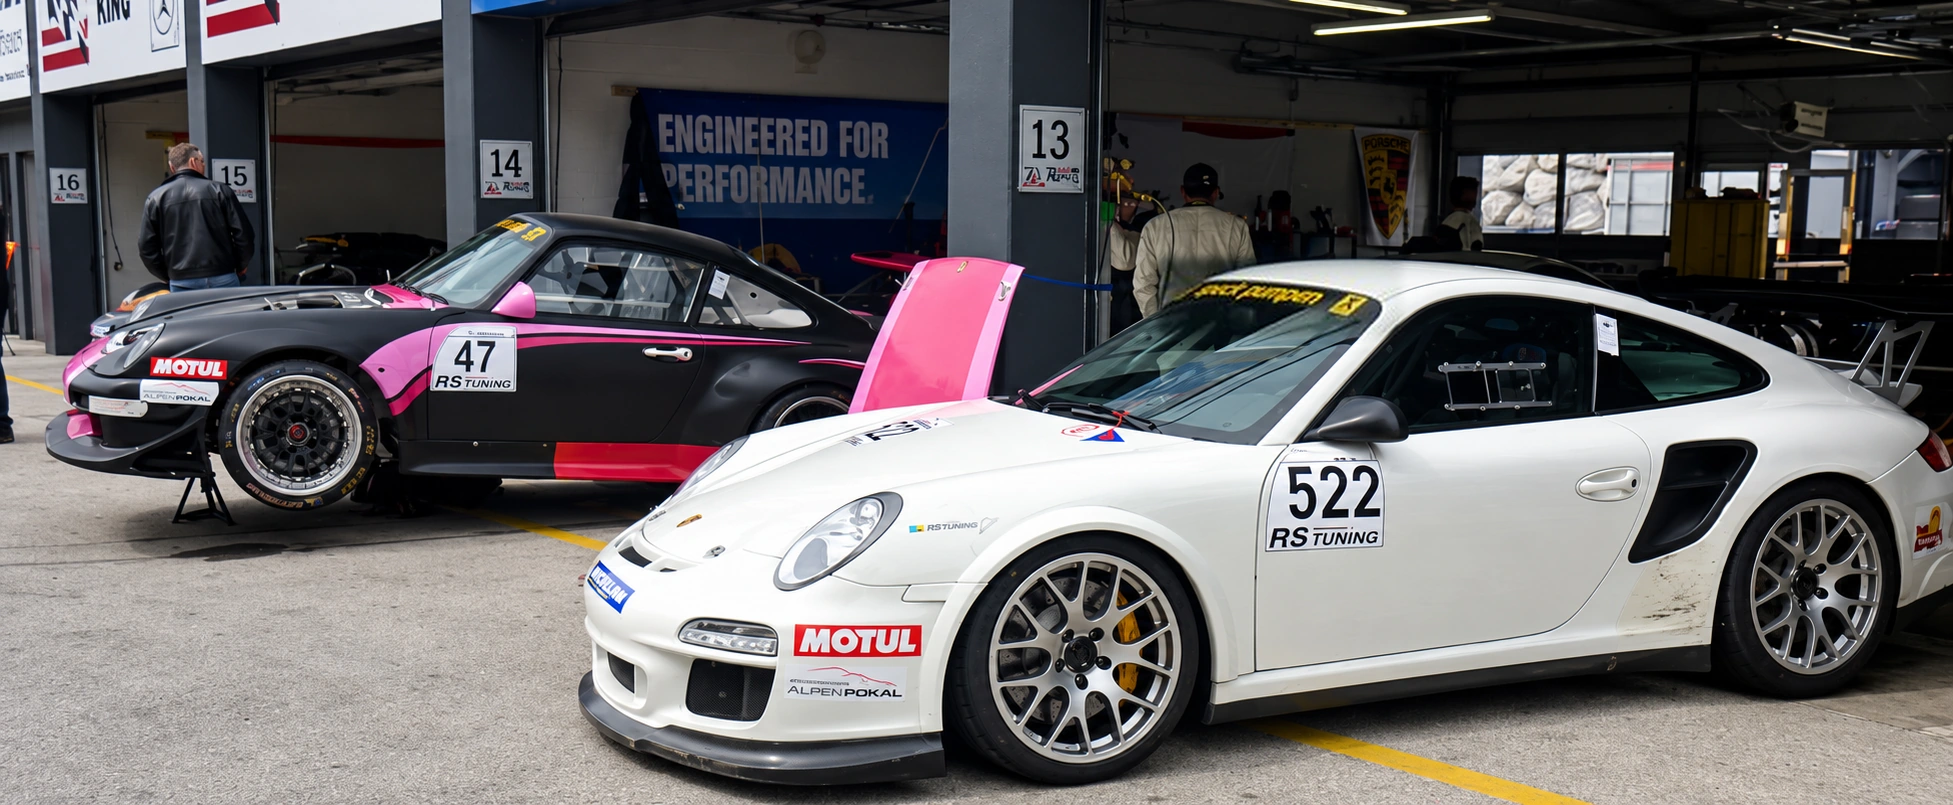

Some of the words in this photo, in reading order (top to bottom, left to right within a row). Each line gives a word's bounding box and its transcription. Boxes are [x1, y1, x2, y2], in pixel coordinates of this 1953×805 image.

[97, 0, 131, 26] KING
[658, 113, 828, 157] ENGINEERED
[839, 120, 889, 159] FOR
[1032, 119, 1070, 160] 13
[1364, 137, 1410, 154] PORSCHE
[490, 148, 523, 178] 14
[57, 174, 80, 191] 16
[221, 165, 248, 187] 15
[153, 359, 223, 377] MOTUL
[454, 340, 496, 372] 47
[435, 376, 463, 388] RS
[465, 380, 511, 388] TUNING
[1287, 465, 1381, 520] 522
[1269, 527, 1309, 548] RS
[1313, 531, 1379, 546] TUNING
[799, 628, 917, 654] MOTUL
[788, 685, 903, 698] ALPENPOKAL
